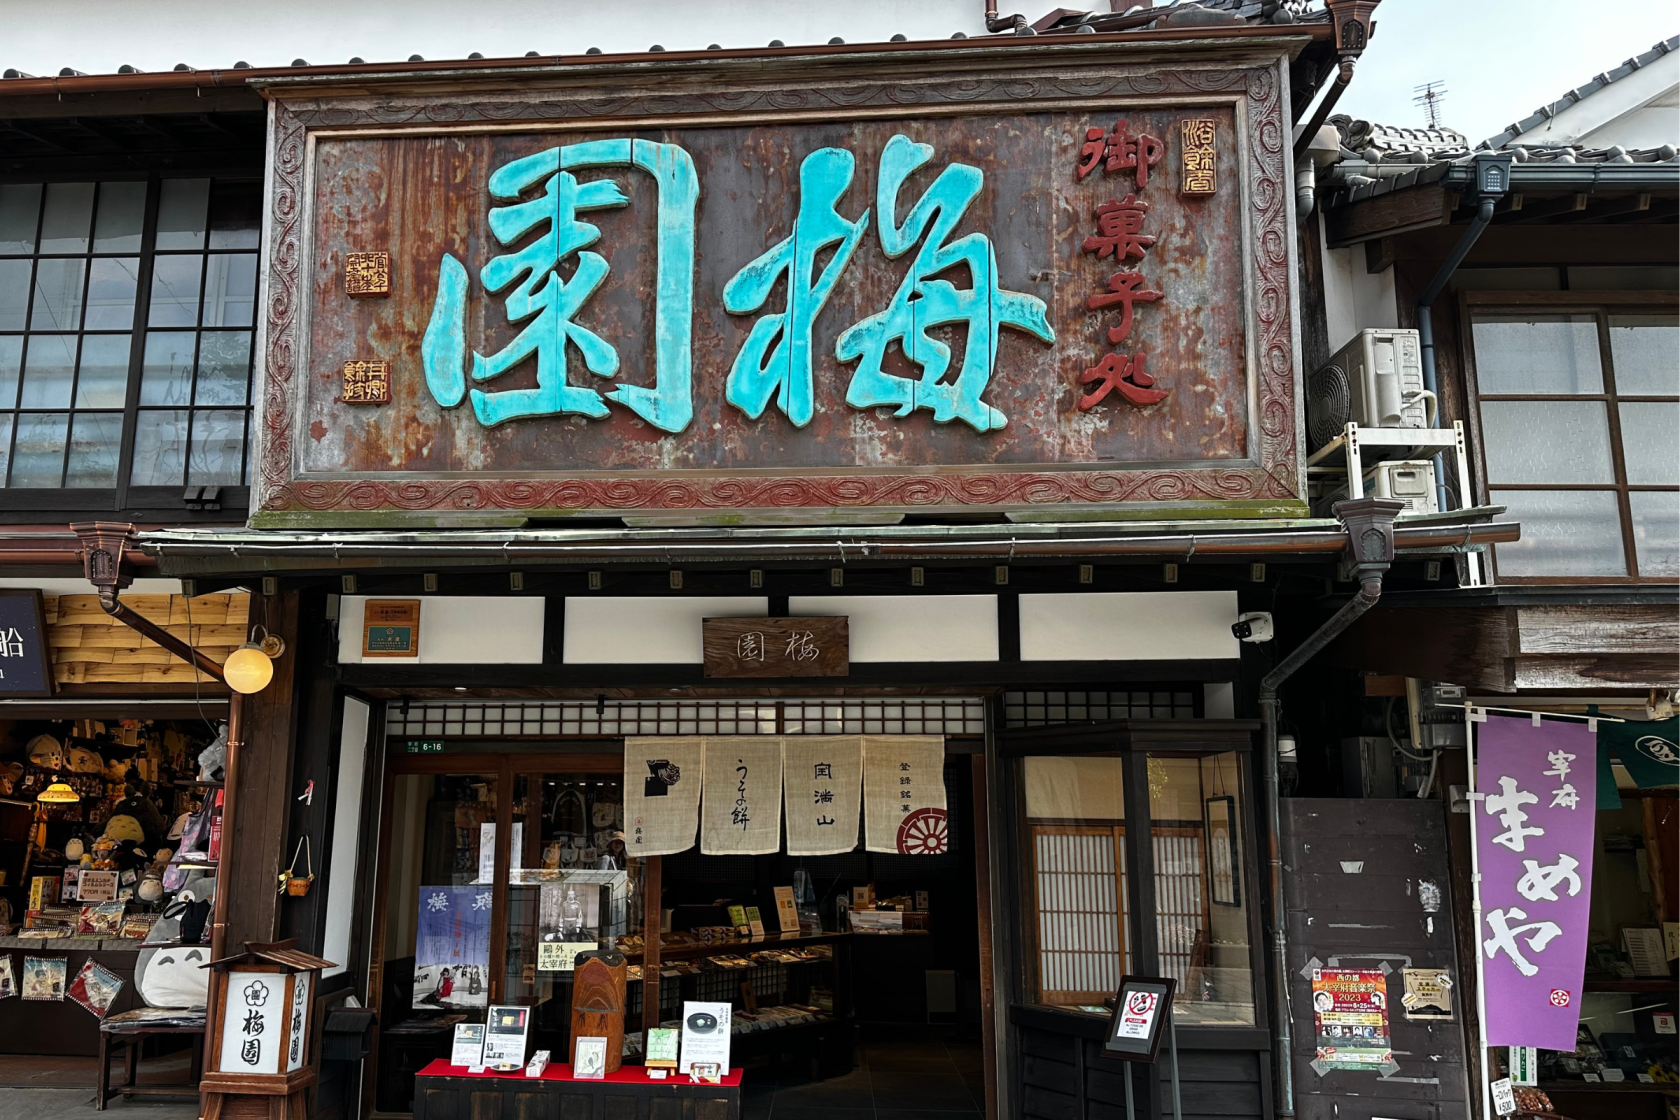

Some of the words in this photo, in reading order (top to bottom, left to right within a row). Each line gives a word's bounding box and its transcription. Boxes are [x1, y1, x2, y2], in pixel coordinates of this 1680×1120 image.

[422, 743, 442, 751] 6-16
[731, 758, 750, 832] うその餅
[813, 761, 836, 827] 宝満山
[899, 761, 913, 814] 登録銘菓
[1543, 749, 1580, 811] 宰府
[1483, 775, 1582, 977] まめや
[539, 959, 568, 969] 太宰府
[1322, 982, 1376, 993] 太宰府音楽祭
[1337, 974, 1360, 982] 西の都
[1338, 993, 1361, 1002] 2023
[241, 1008, 265, 1066] 梅園
[290, 1008, 302, 1063] 梅園
